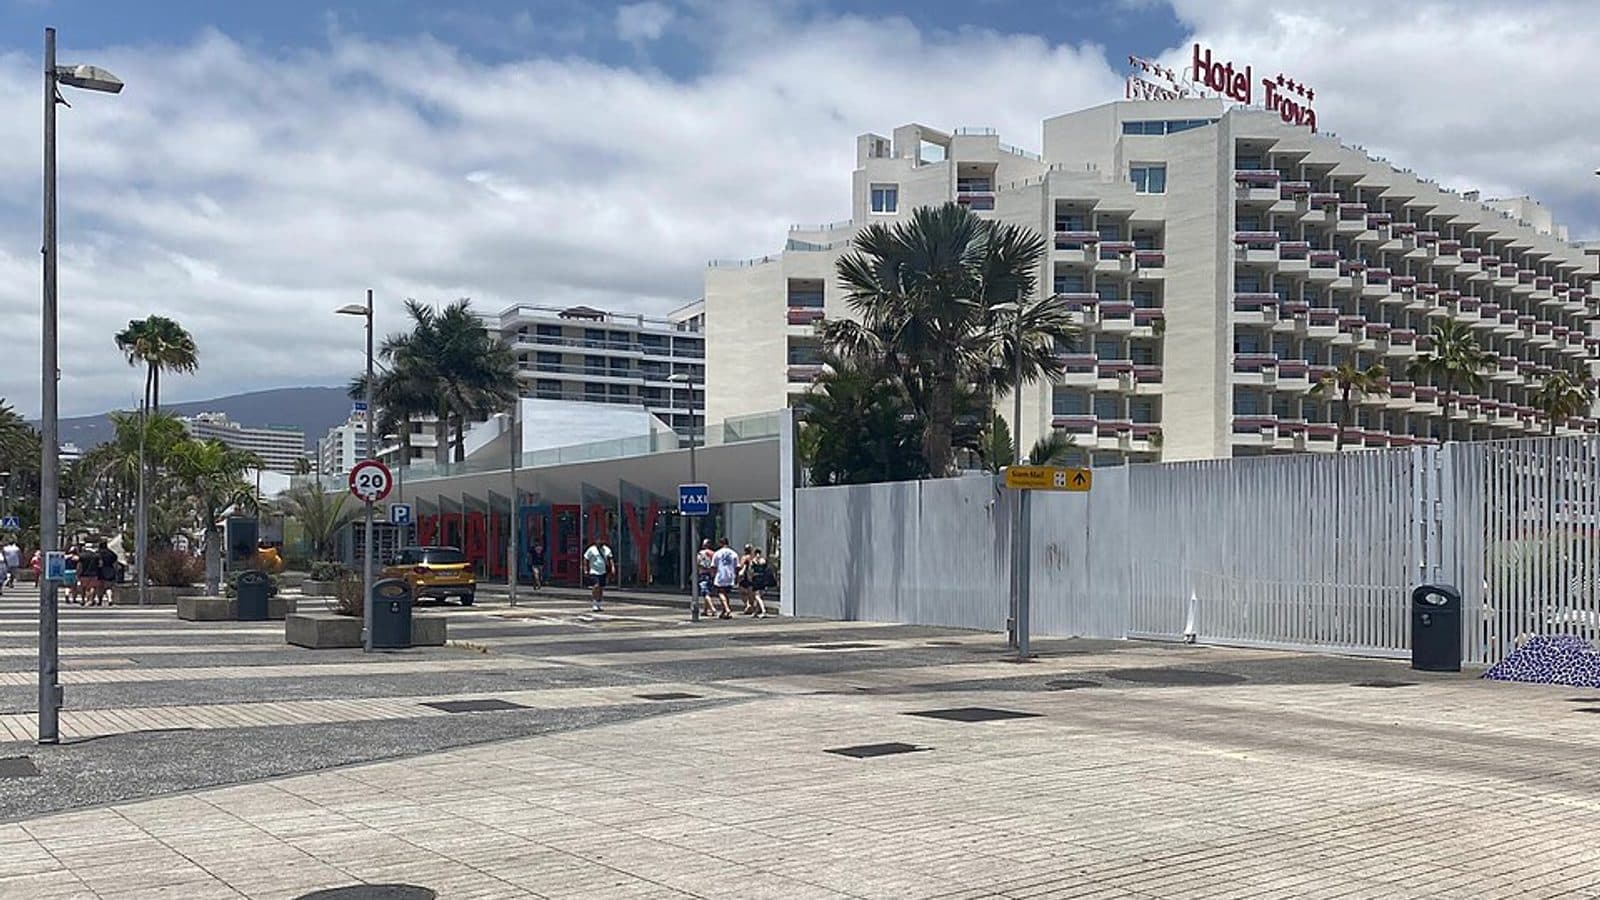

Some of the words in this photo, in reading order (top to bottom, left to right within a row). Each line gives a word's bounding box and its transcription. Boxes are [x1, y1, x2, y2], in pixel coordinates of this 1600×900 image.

[1193, 43, 1251, 105] Hotel
[360, 474, 383, 488] 20
[682, 495, 708, 504] TAXI
[394, 507, 408, 523] P
